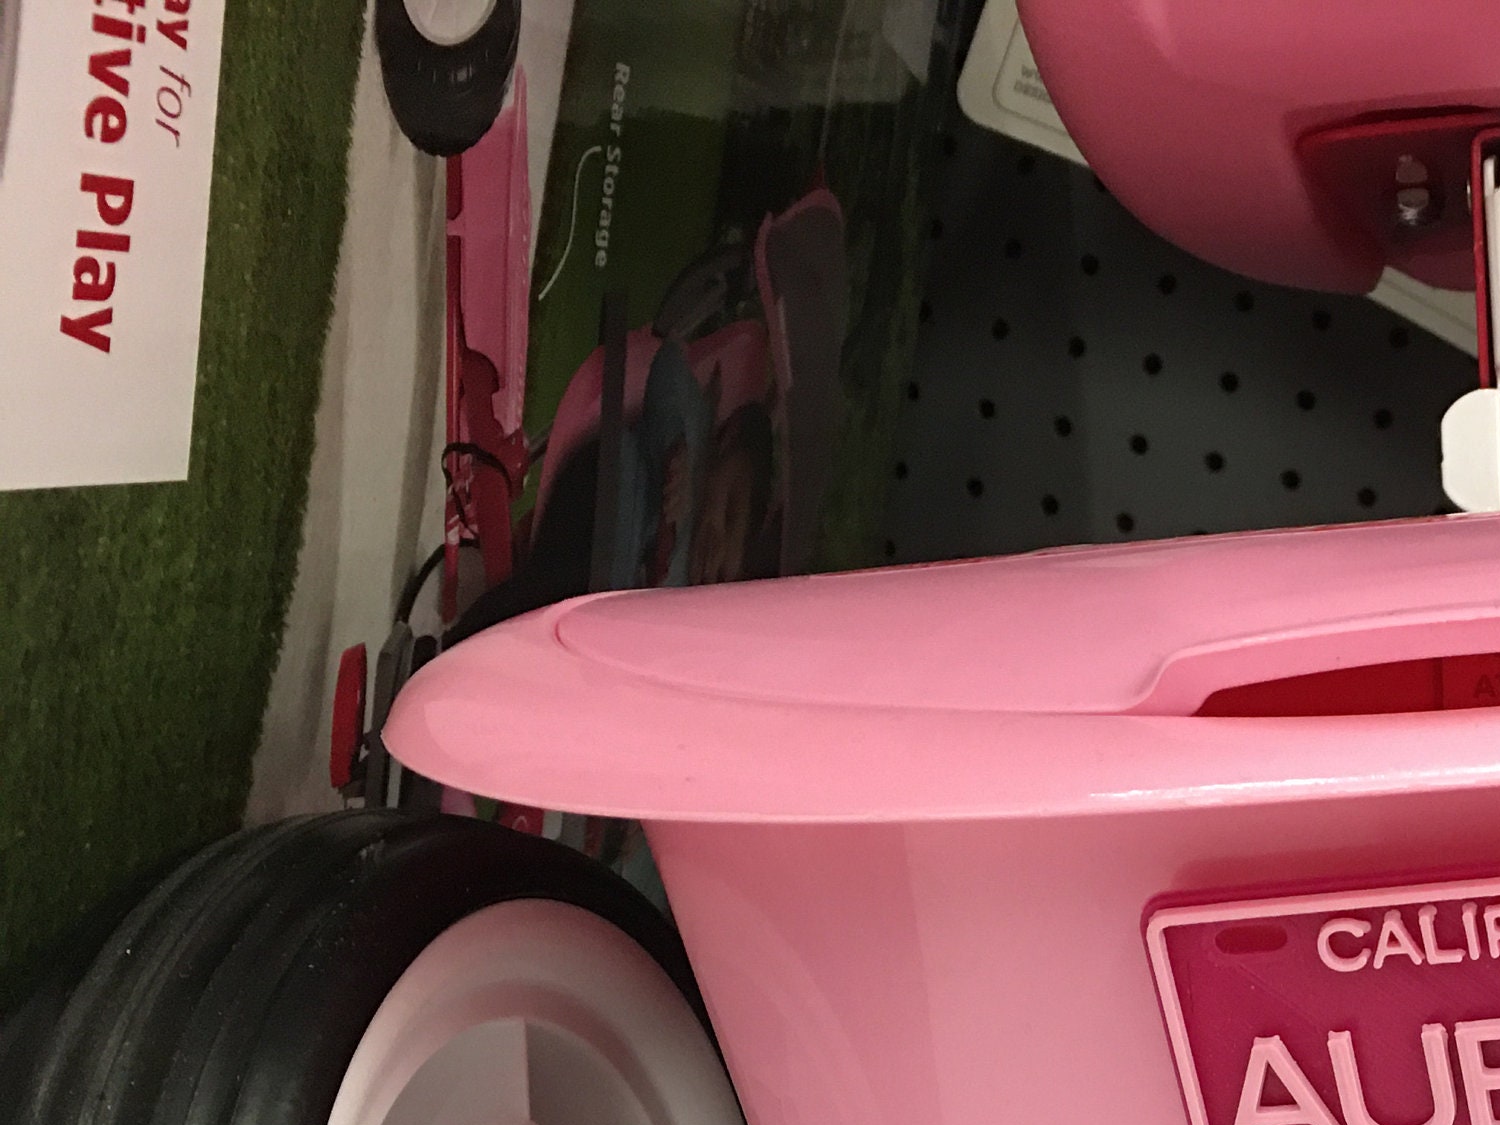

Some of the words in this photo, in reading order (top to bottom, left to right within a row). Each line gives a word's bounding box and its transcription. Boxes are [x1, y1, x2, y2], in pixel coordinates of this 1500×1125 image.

[154, 65, 192, 148] for
[609, 61, 631, 137] Rear
[594, 144, 622, 268] Storage
[59, 172, 135, 354] Play
